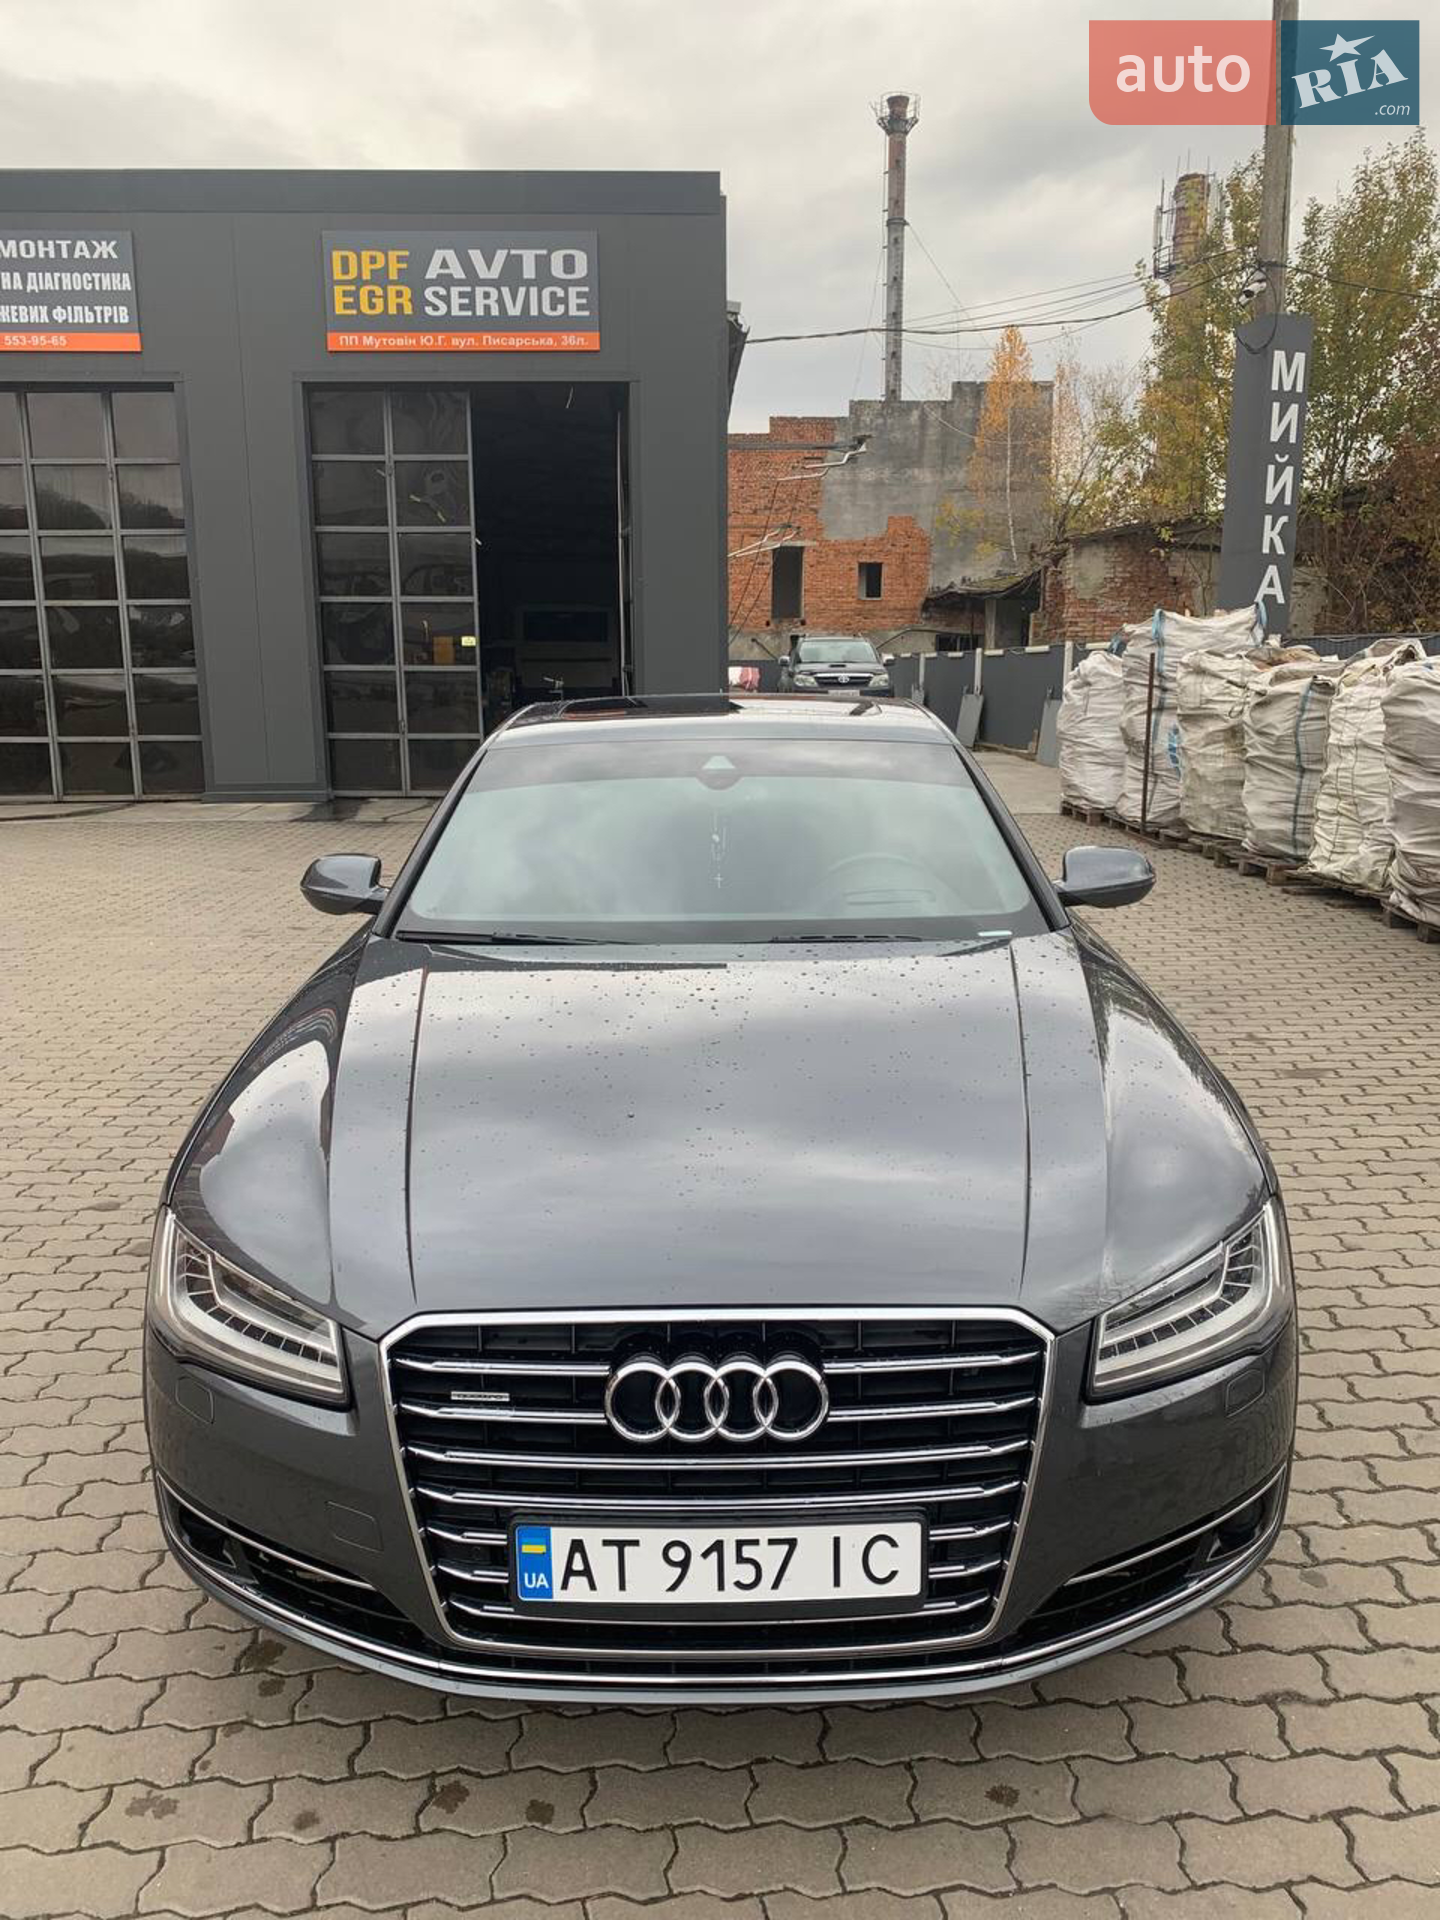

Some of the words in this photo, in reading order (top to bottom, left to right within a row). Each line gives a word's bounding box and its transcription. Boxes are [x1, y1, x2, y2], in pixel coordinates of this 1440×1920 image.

[0, 239, 118, 259] МОНТАЖ
[332, 250, 410, 280] DPF
[425, 249, 588, 280] AVTO
[1, 271, 23, 291] НА
[26, 271, 132, 293] ДІАГНОСТИКА
[334, 285, 413, 315] EGR
[424, 286, 590, 316] SERVICE
[52, 305, 130, 324] ФІЛЬТРІВ
[4, 335, 67, 346] 553-95-65
[339, 335, 358, 346] ПП
[363, 335, 416, 349] Мутовін
[451, 337, 479, 349] вул.
[1253, 349, 1307, 604] МИЙКА
[560, 1538, 640, 1591] AT
[662, 1537, 798, 1592] 9157
[833, 1533, 899, 1588] IC
[524, 1573, 549, 1589] UA
